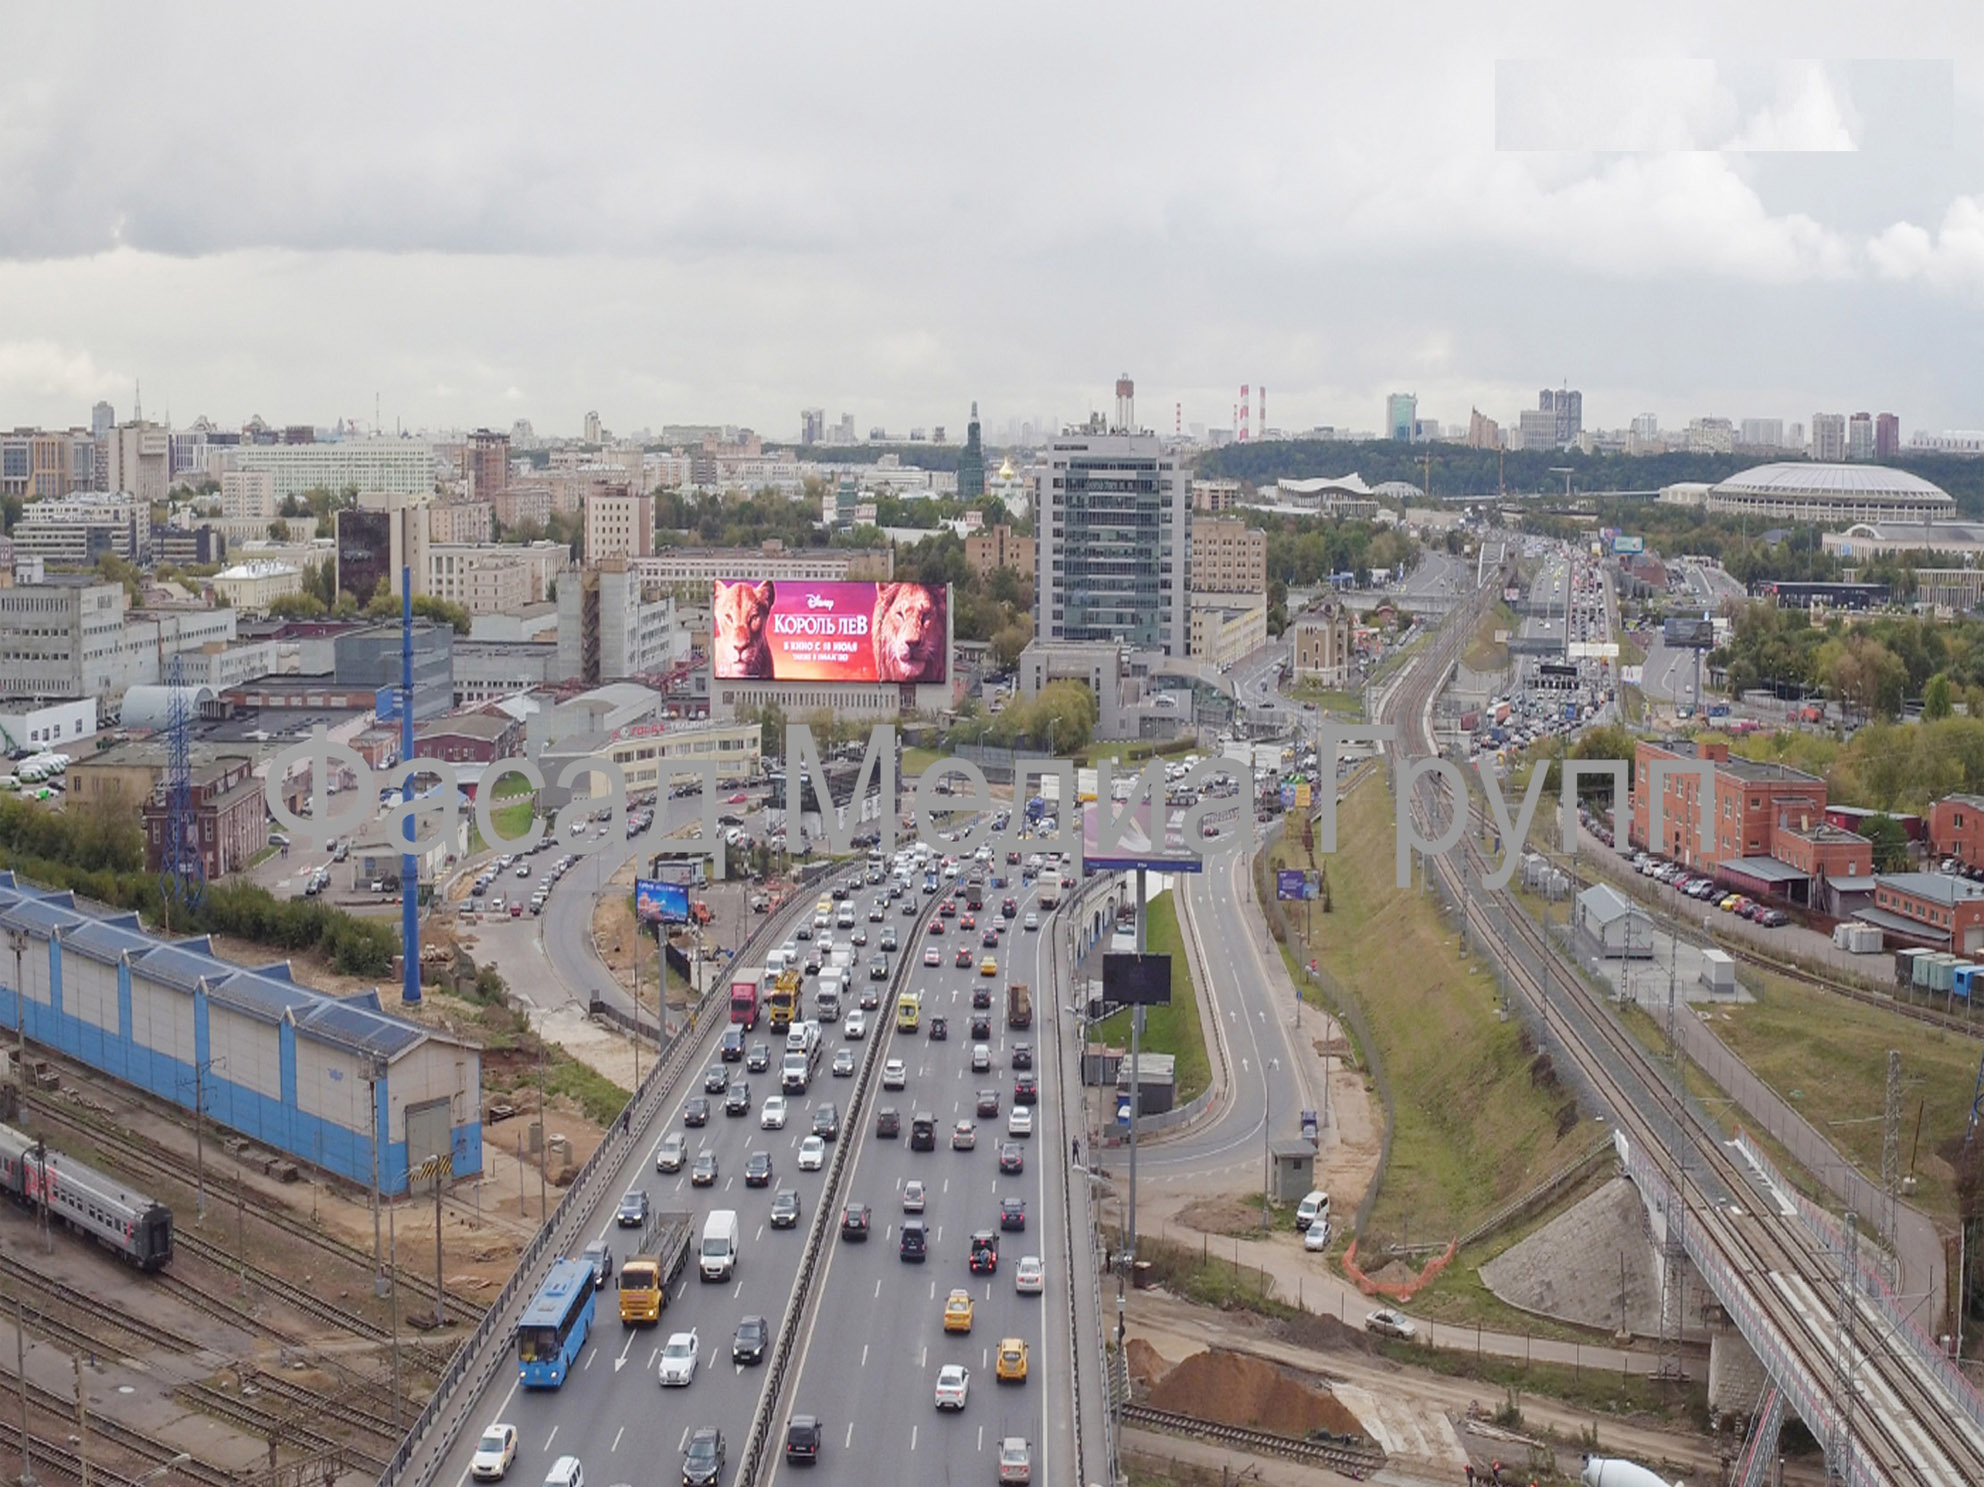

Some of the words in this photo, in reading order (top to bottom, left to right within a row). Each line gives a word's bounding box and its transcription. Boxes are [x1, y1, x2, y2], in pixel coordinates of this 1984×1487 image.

[806, 594, 834, 611] Disney
[774, 614, 836, 635] КОРОЛЬ
[837, 615, 868, 635] ЛЕВ
